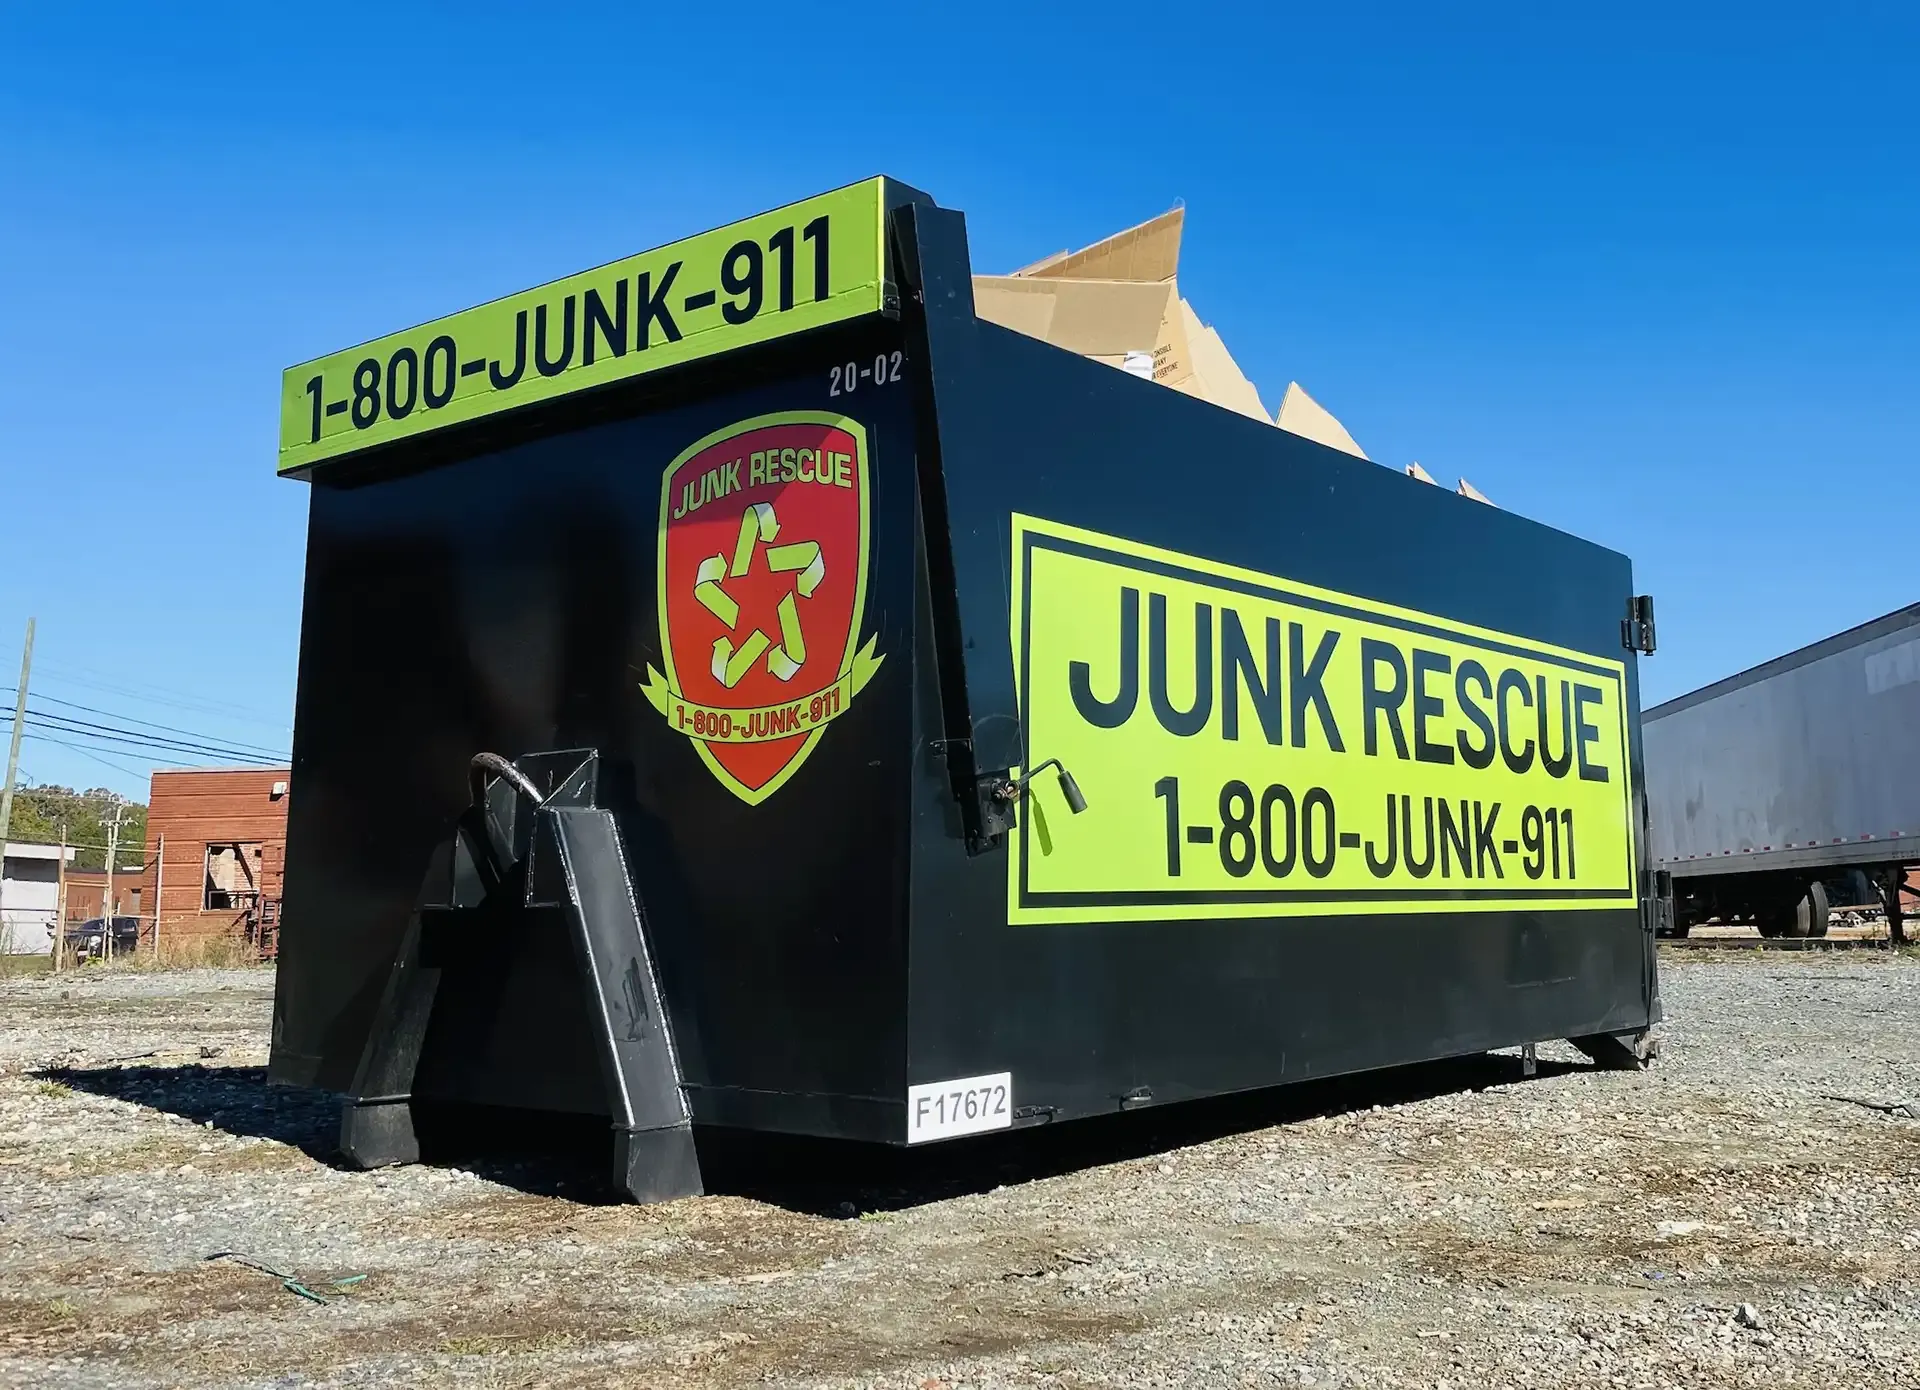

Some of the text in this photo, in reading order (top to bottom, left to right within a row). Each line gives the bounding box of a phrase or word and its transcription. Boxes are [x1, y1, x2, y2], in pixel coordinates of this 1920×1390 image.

[307, 215, 831, 443] 1-800-JUNK-911
[829, 350, 903, 397] 20-02
[673, 447, 854, 521] JUNK RESCUE
[676, 687, 841, 739] 1-800-JUNK-911
[1069, 587, 1610, 783] JUNK RESCUE
[1154, 776, 1576, 879] 1-800-JUNK-911
[916, 1084, 1006, 1128] F17672
